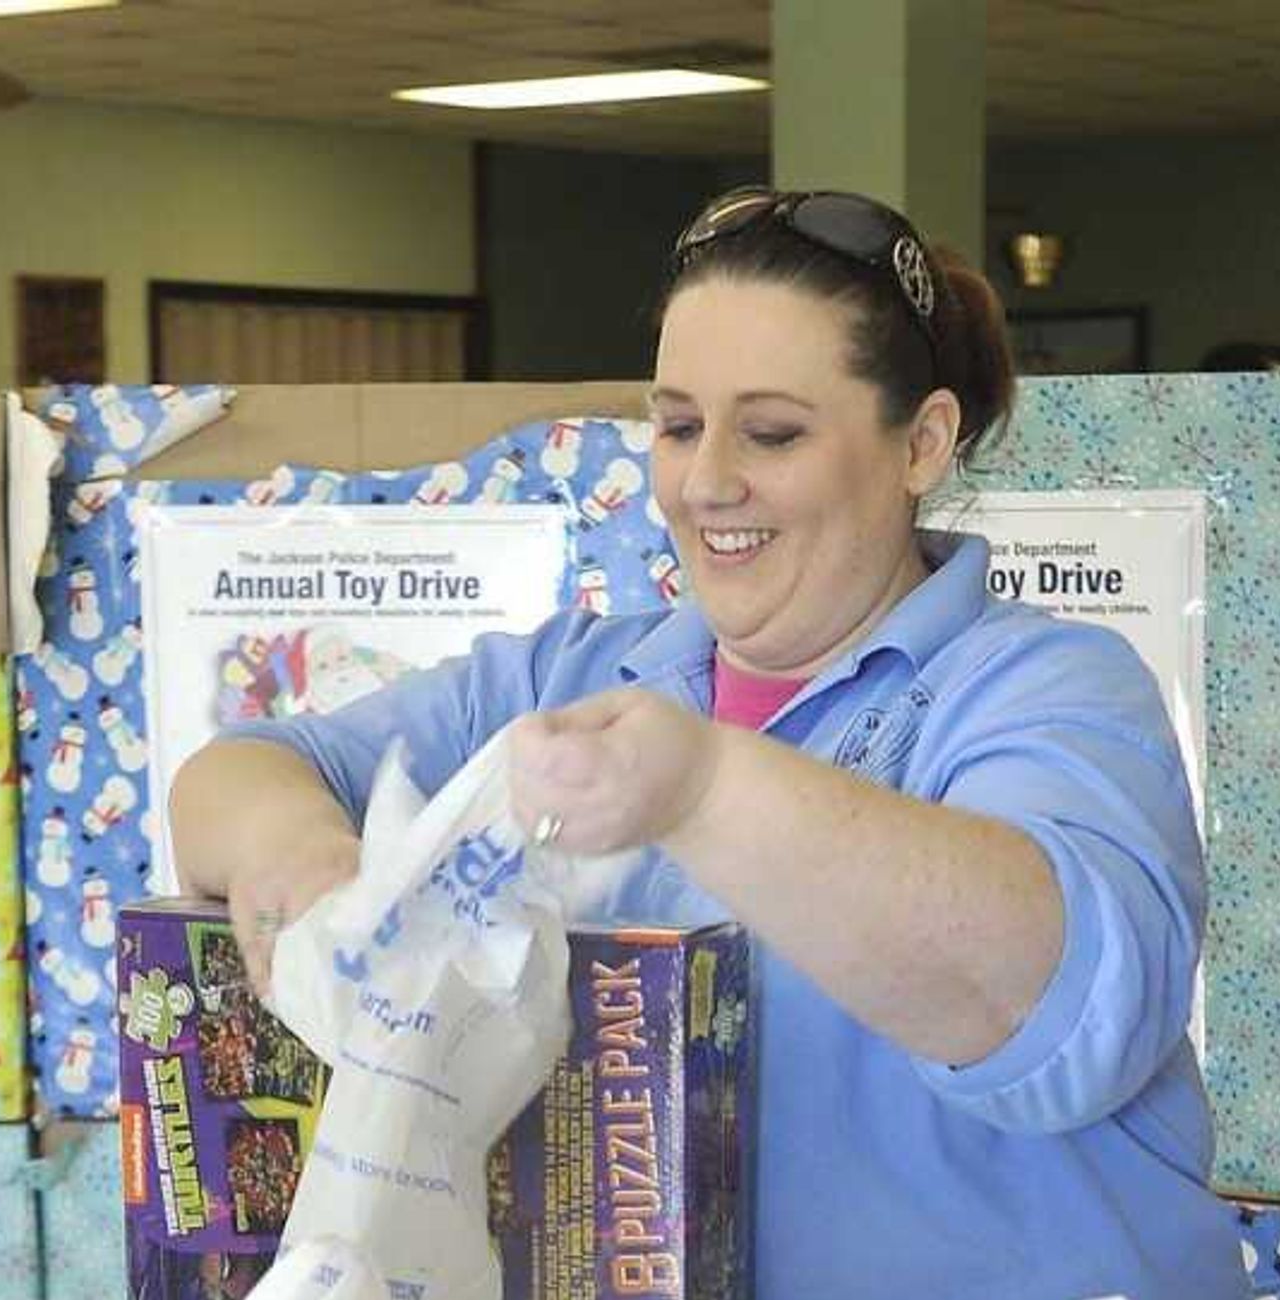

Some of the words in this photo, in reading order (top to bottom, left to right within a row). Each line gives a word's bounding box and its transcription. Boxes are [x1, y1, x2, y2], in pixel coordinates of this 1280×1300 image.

[238, 552, 260, 564] The
[270, 552, 323, 564] Jackson
[329, 552, 369, 564] Police
[374, 552, 456, 566] Department
[1014, 543, 1097, 558] Department
[214, 570, 324, 600] Annual
[335, 570, 387, 606] Toy
[399, 570, 480, 600] Drive
[990, 569, 1025, 599] oy
[1039, 562, 1123, 595] Drive
[591, 958, 650, 1079] PACK
[157, 1056, 208, 1231] TURTLES
[604, 1088, 663, 1246] PUZZLE
